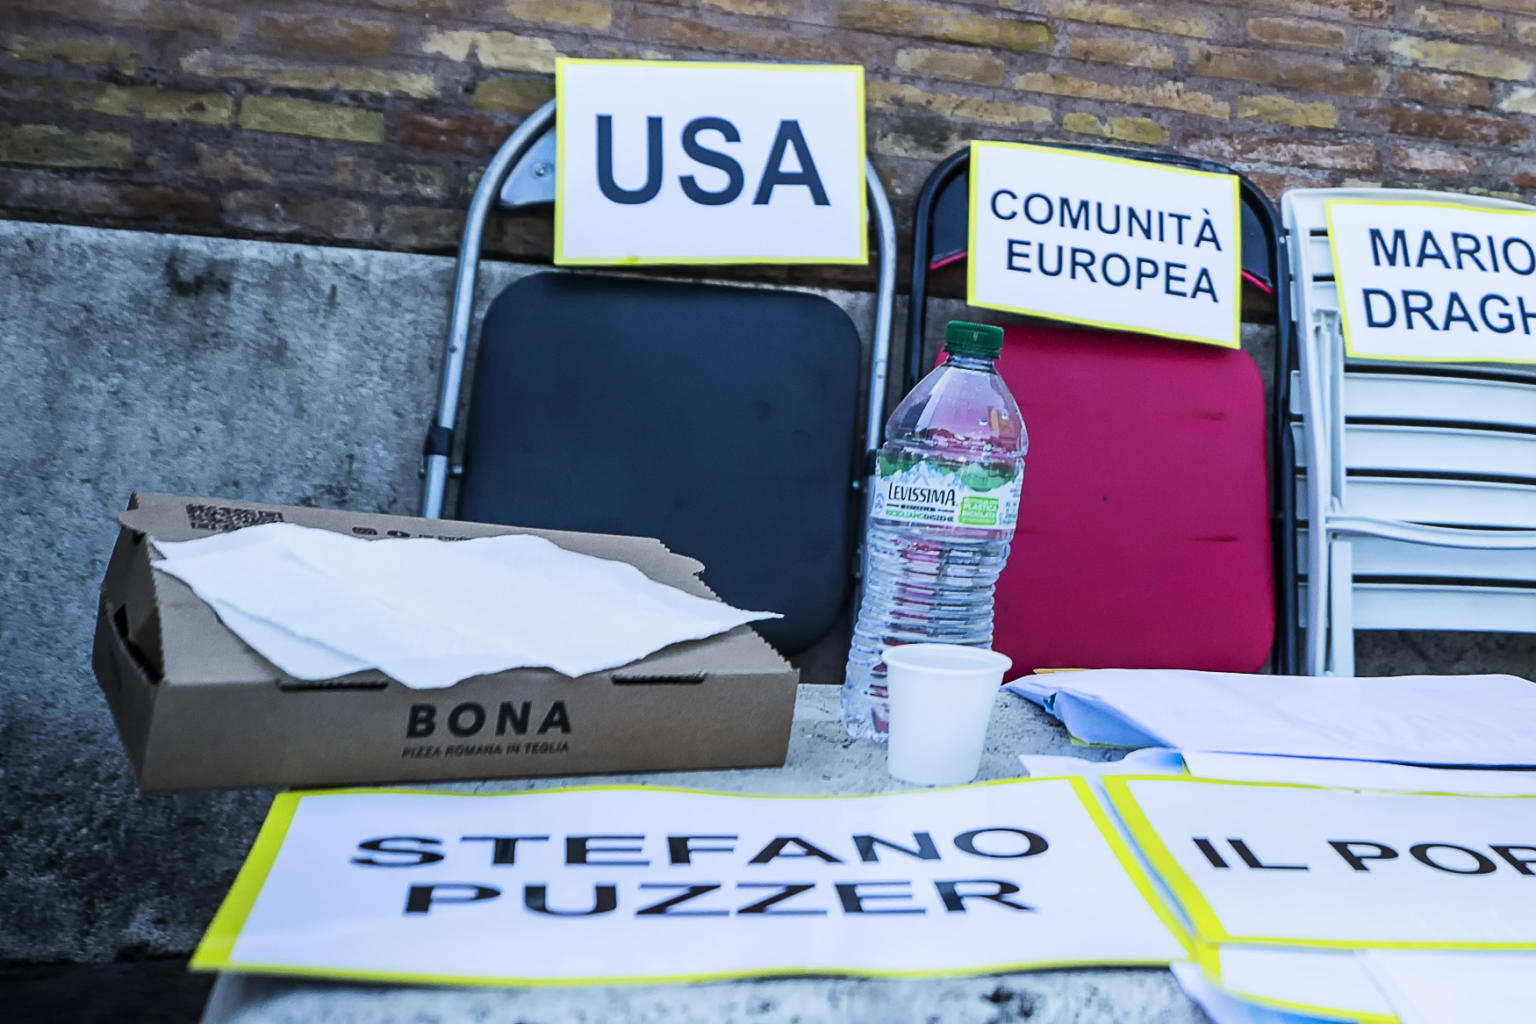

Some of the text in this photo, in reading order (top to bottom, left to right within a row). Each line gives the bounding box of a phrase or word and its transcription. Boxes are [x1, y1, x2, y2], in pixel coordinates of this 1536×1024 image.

[596, 114, 831, 206] USA
[991, 189, 1222, 252] COMUNITÀ
[1007, 239, 1219, 303] EUROPEA
[1369, 228, 1536, 276] MARIO
[888, 482, 956, 507] LEVISSIMA
[405, 700, 573, 739] BONA
[401, 741, 570, 760] PIZZA ROMANA IN TEGLIA
[350, 827, 1049, 868] STEFANO
[1192, 838, 1309, 871] IL
[403, 879, 1036, 917] PUZZER
